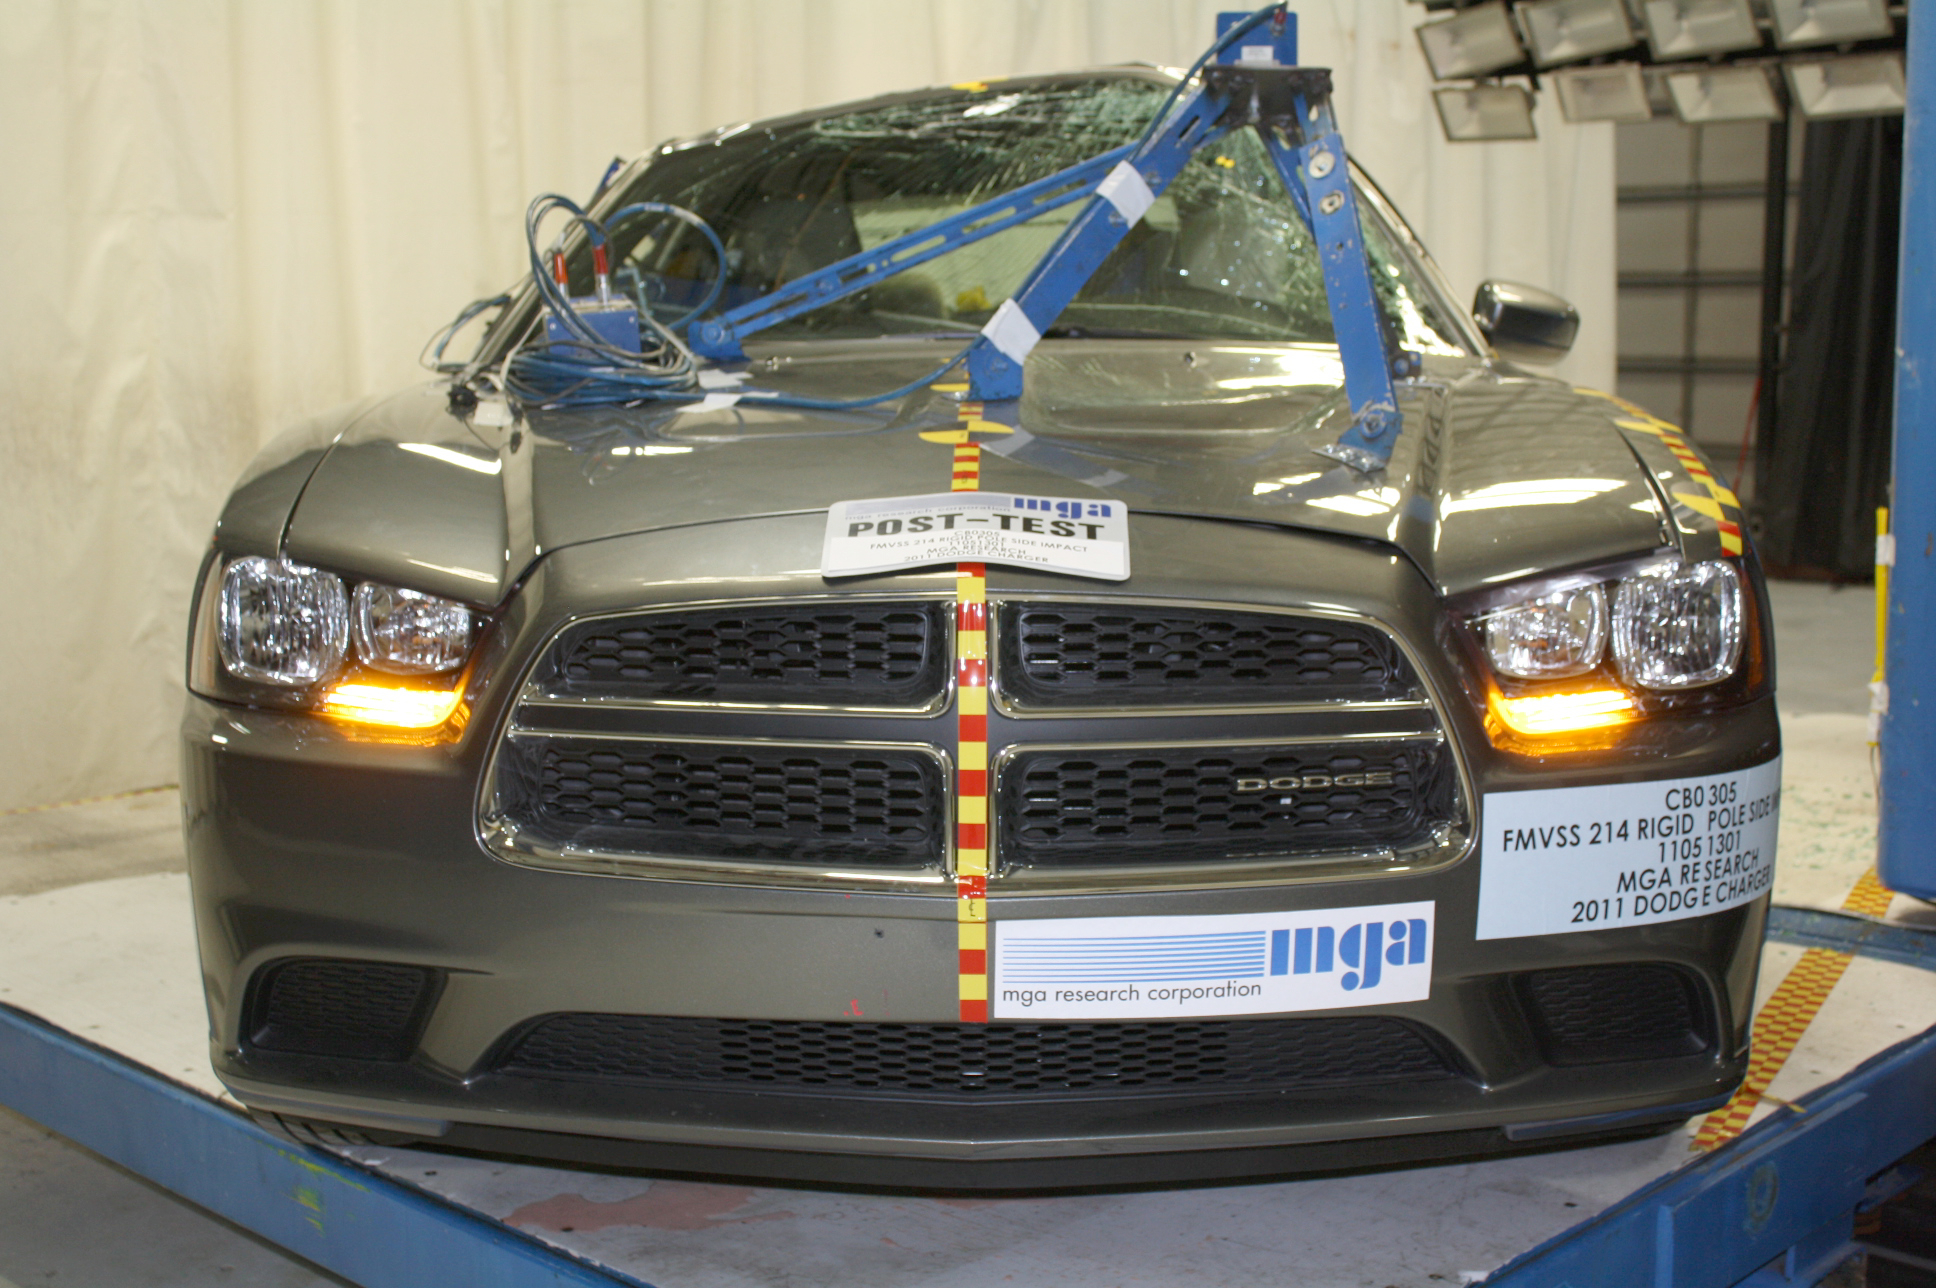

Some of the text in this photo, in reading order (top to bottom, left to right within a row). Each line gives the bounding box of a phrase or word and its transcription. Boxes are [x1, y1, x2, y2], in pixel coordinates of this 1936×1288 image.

[1014, 498, 1112, 519] mga
[870, 534, 1088, 552] FMVSS 214 RIGID POLE SIDE IMPACT
[926, 545, 1027, 555] MGA RESEARCH
[904, 549, 1049, 563] 2011 DODGE CHARGER
[1237, 772, 1393, 791] DODGE
[1503, 823, 1581, 852] FMVSS
[1589, 819, 1629, 845] 214
[1638, 813, 1694, 840] RIGID
[1708, 804, 1745, 831] POLE
[1748, 795, 1770, 822] SIDE
[1616, 868, 1672, 893] MGA
[1571, 898, 1623, 923] 2011
[1270, 918, 1428, 991] mga
[1003, 980, 1262, 1007] mga research corporation
